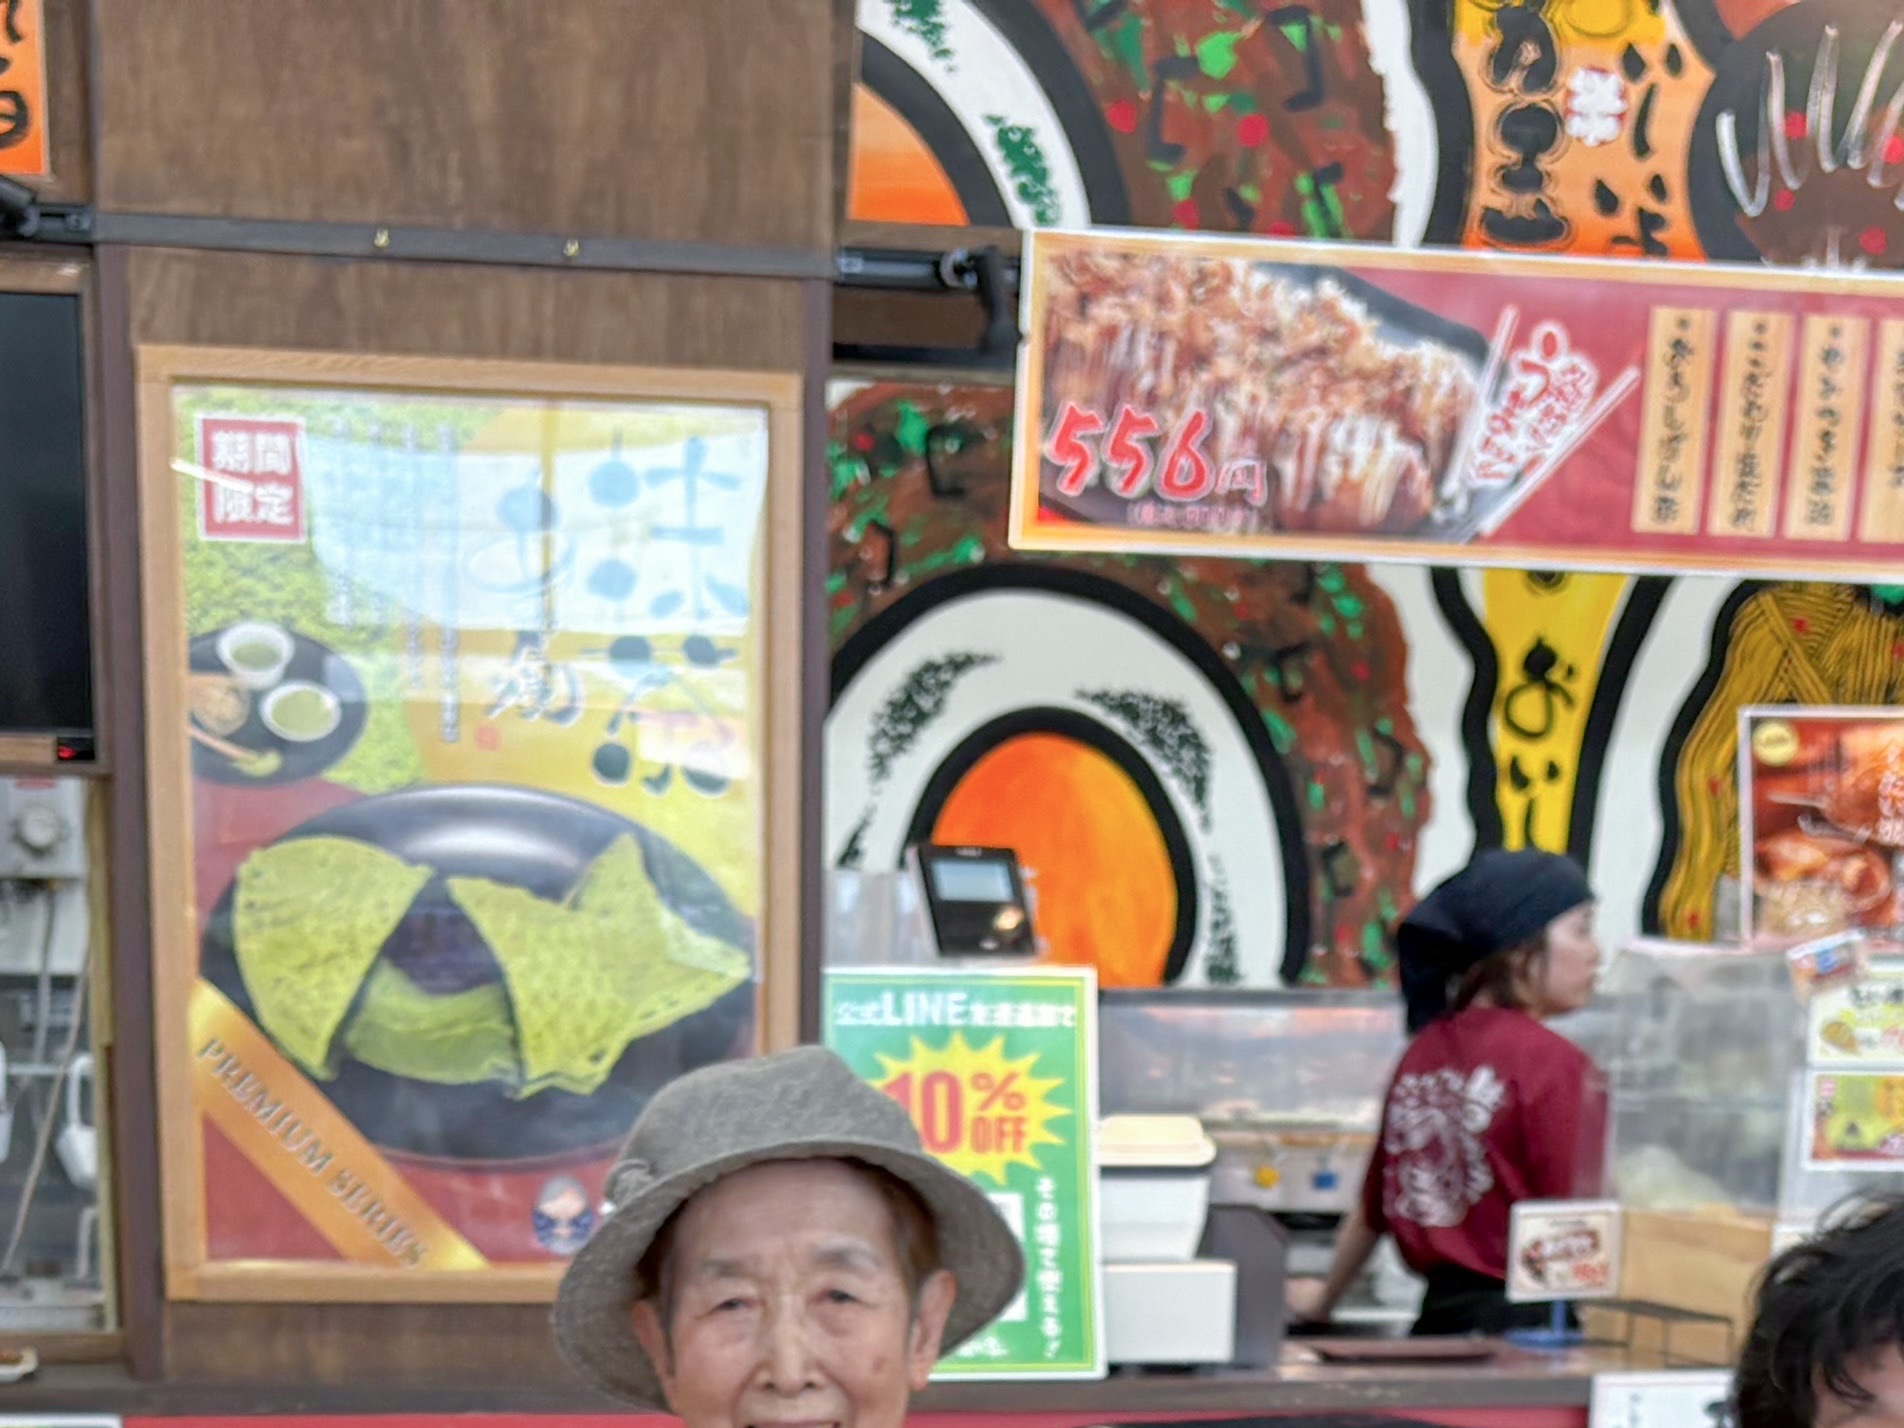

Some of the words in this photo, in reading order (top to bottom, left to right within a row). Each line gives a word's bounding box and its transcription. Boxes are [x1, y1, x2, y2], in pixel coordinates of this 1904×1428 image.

[211, 430, 293, 475] 期間
[1046, 402, 1268, 505] 556円
[197, 1038, 336, 1177] PREMIUM
[326, 1168, 428, 1267] SERIES
[970, 1116, 1027, 1154] OFF
